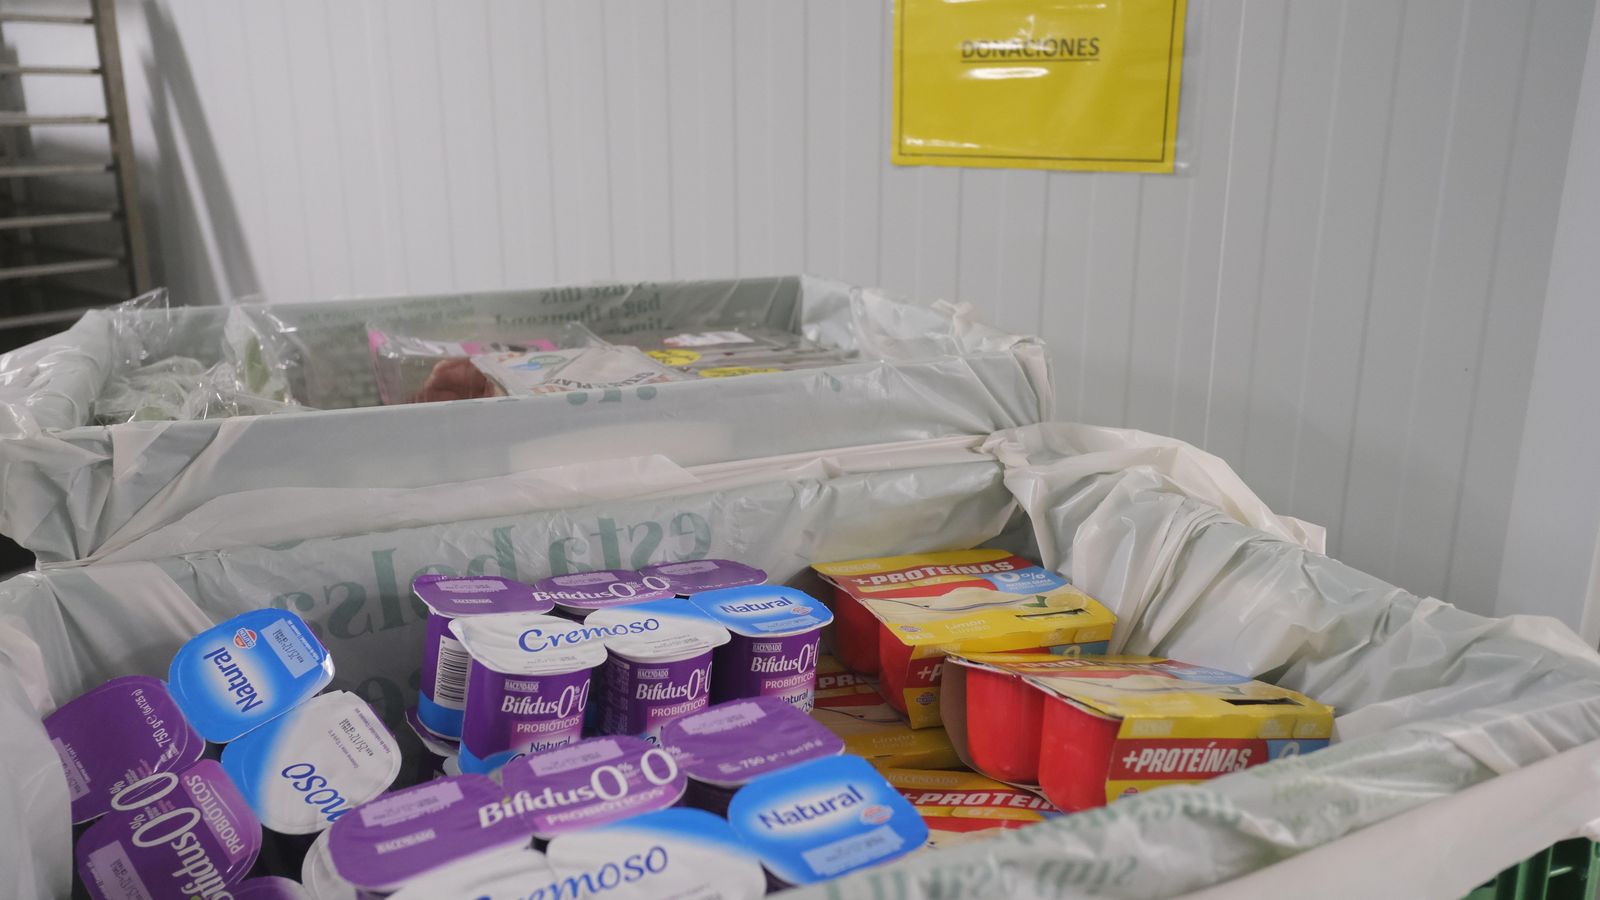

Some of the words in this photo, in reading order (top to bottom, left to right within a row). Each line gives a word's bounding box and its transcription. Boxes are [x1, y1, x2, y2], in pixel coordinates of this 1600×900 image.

[961, 37, 1100, 62] DONACIONES
[850, 561, 1015, 586] +PROTEÍNAS
[719, 596, 793, 615] Natural
[518, 617, 660, 653] Cremoso
[203, 646, 264, 713] Natural
[1122, 741, 1253, 773] +PROTEÍNAS
[757, 784, 865, 831] Natural
